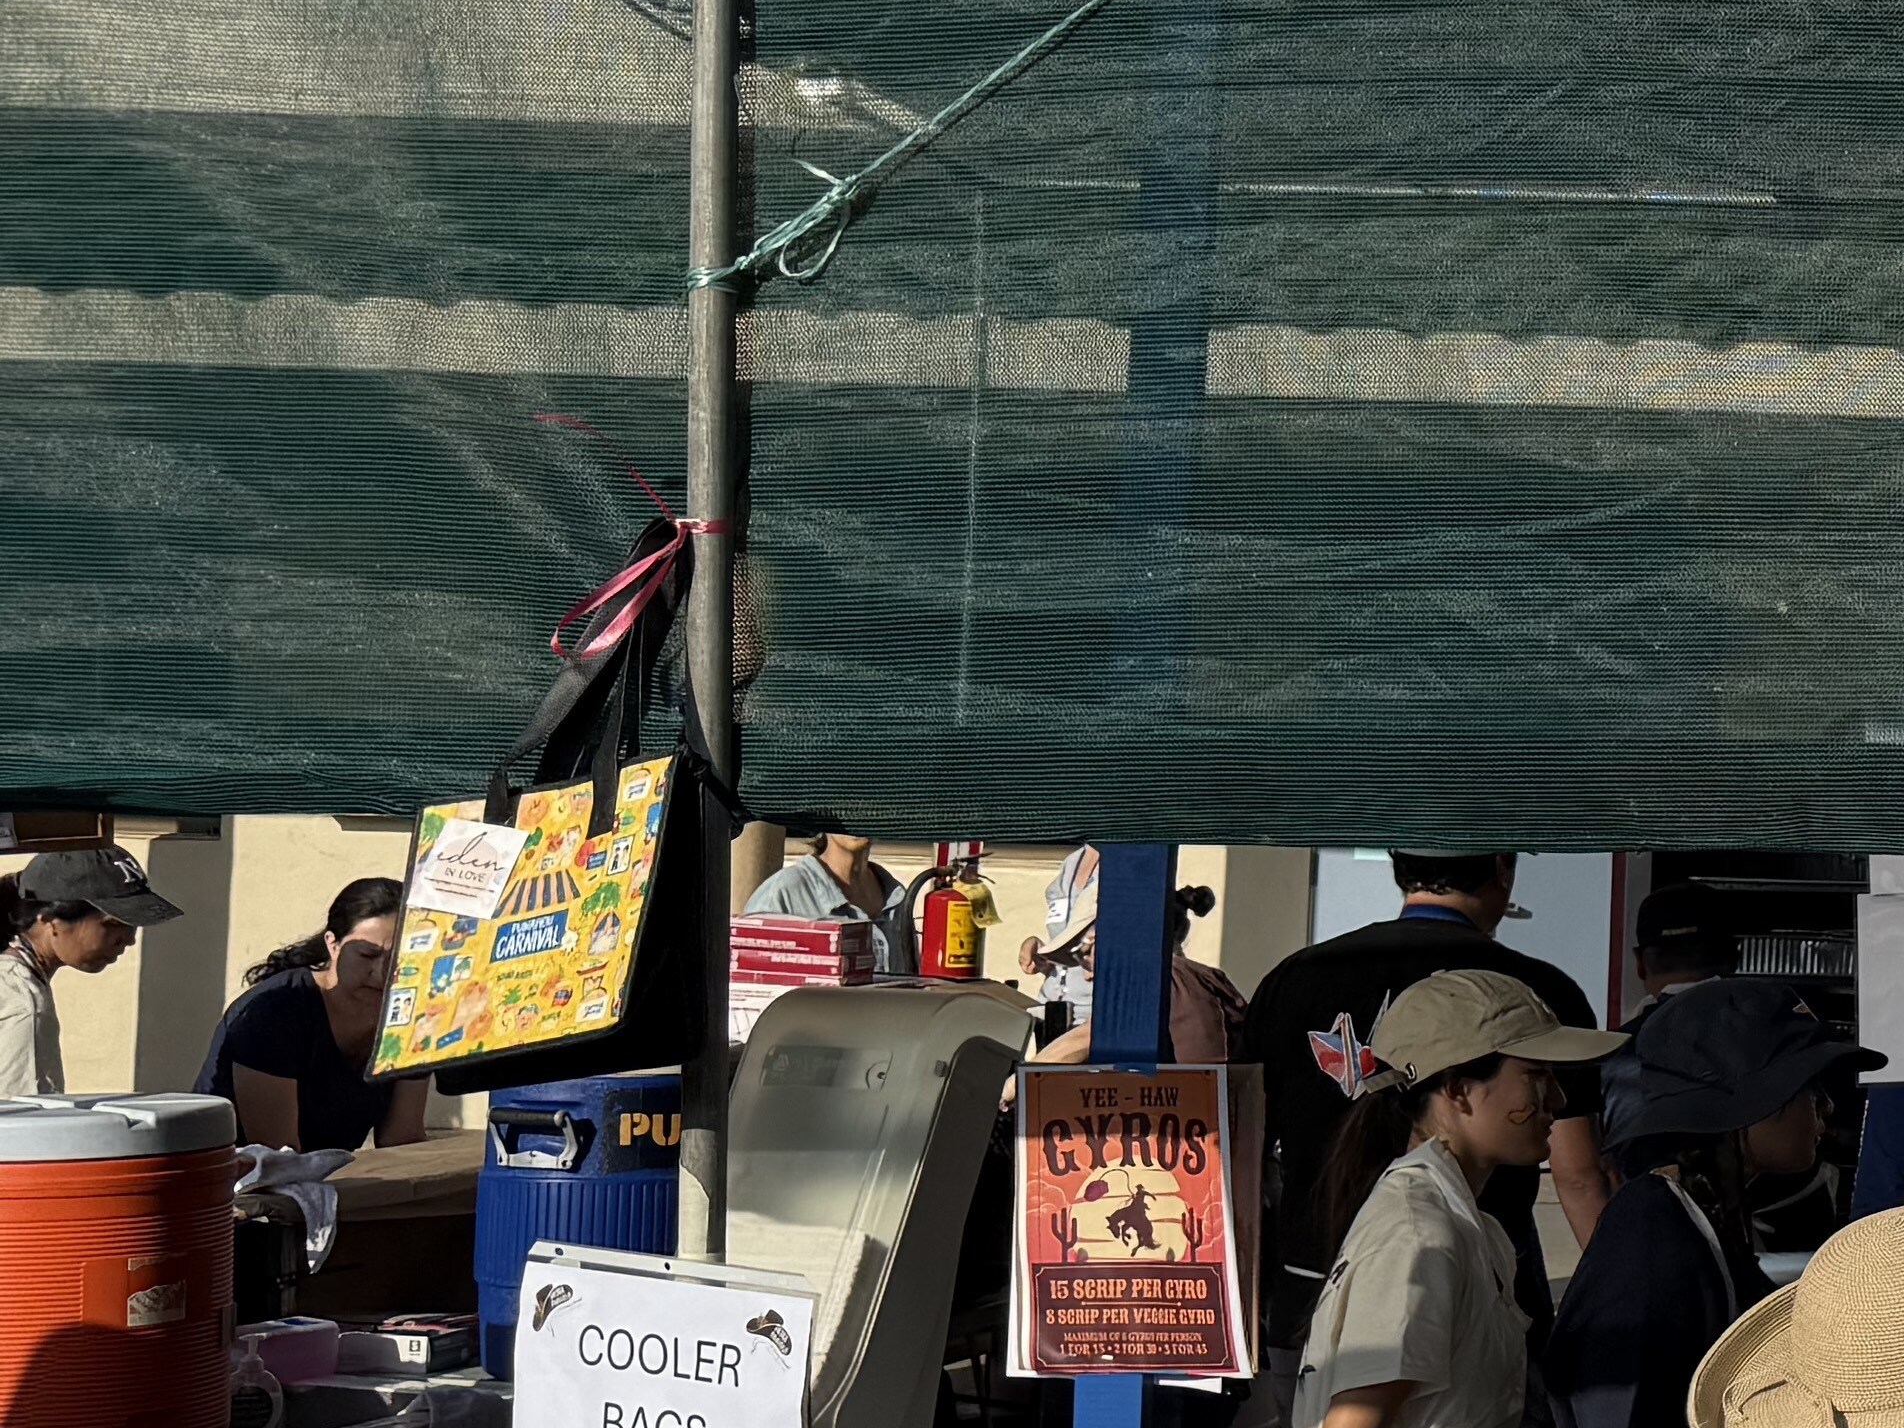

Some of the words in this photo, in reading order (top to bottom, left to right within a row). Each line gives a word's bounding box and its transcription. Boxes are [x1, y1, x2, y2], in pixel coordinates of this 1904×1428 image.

[459, 870, 486, 883] LOVE
[495, 924, 560, 960] CARNIVAL
[1079, 1086, 1119, 1108] YEE
[1139, 1086, 1180, 1108] HAW
[1042, 1111, 1208, 1177] GYROS
[1050, 1279, 1069, 1300] 15
[1073, 1278, 1127, 1300] SCRIP
[1131, 1278, 1162, 1300] PER
[1165, 1278, 1208, 1300] GYRO
[1058, 1308, 1100, 1325] SCRIP
[1102, 1307, 1130, 1325] PER
[1133, 1307, 1178, 1325] VEGGIE
[1179, 1308, 1216, 1325] GYRO
[578, 1323, 742, 1388] COOLER
